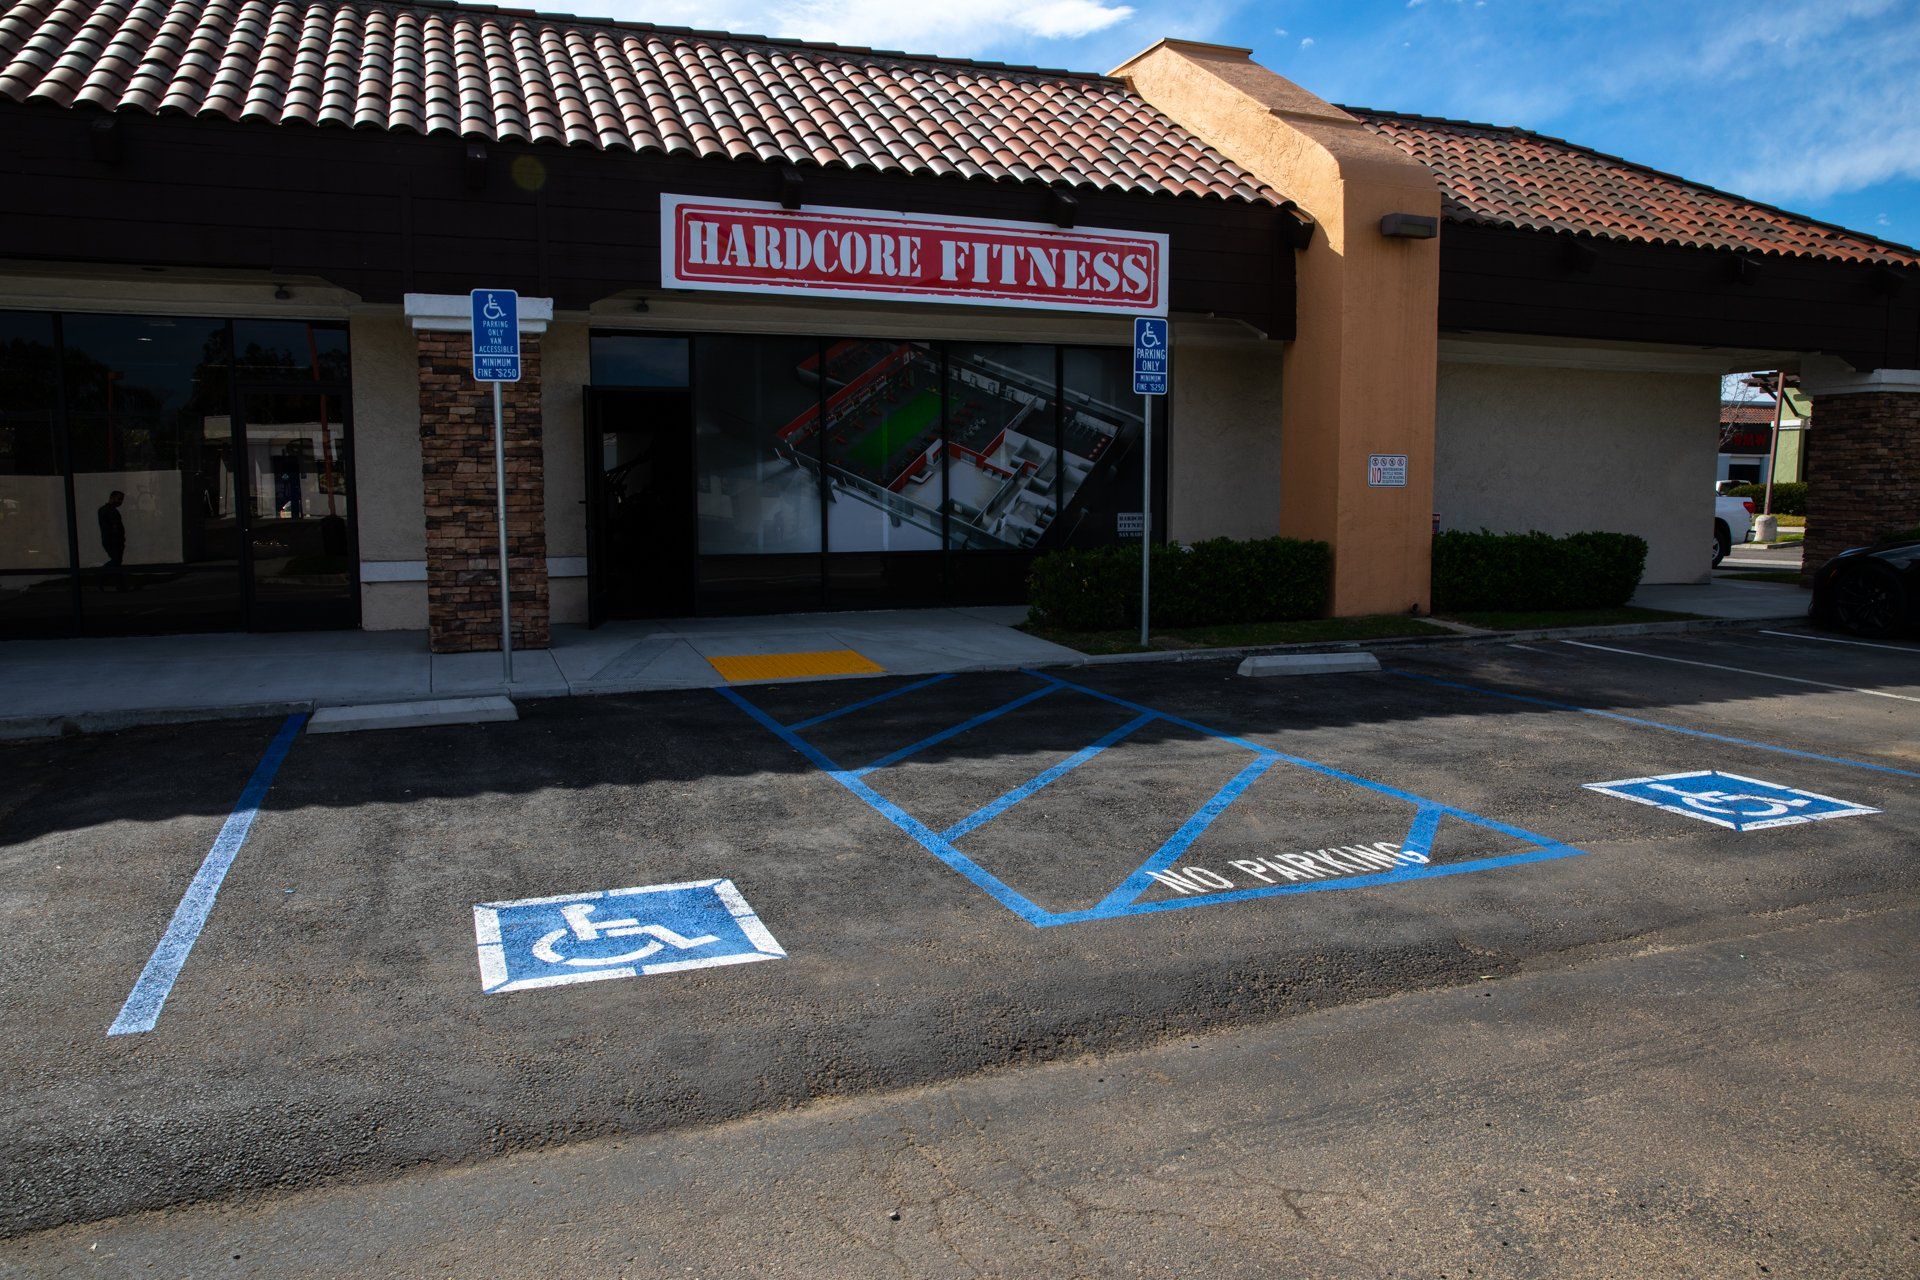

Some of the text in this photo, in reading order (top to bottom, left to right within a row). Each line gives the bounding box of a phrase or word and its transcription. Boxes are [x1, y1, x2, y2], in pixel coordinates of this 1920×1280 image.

[688, 220, 1149, 294] HARDCORE FITNESS
[482, 320, 509, 328] PARKING
[490, 337, 502, 345] VAN
[479, 345, 514, 353] ACCESSIBLE
[1136, 348, 1166, 360] PARKING
[482, 358, 511, 367] MINIMUM
[1142, 360, 1160, 371] ONLY
[477, 368, 517, 378] FINE $250
[1140, 375, 1161, 383] MINIMUM
[1136, 383, 1165, 391] FINE $250
[1372, 467, 1382, 483] NO
[1145, 841, 1430, 894] NO PARKING
